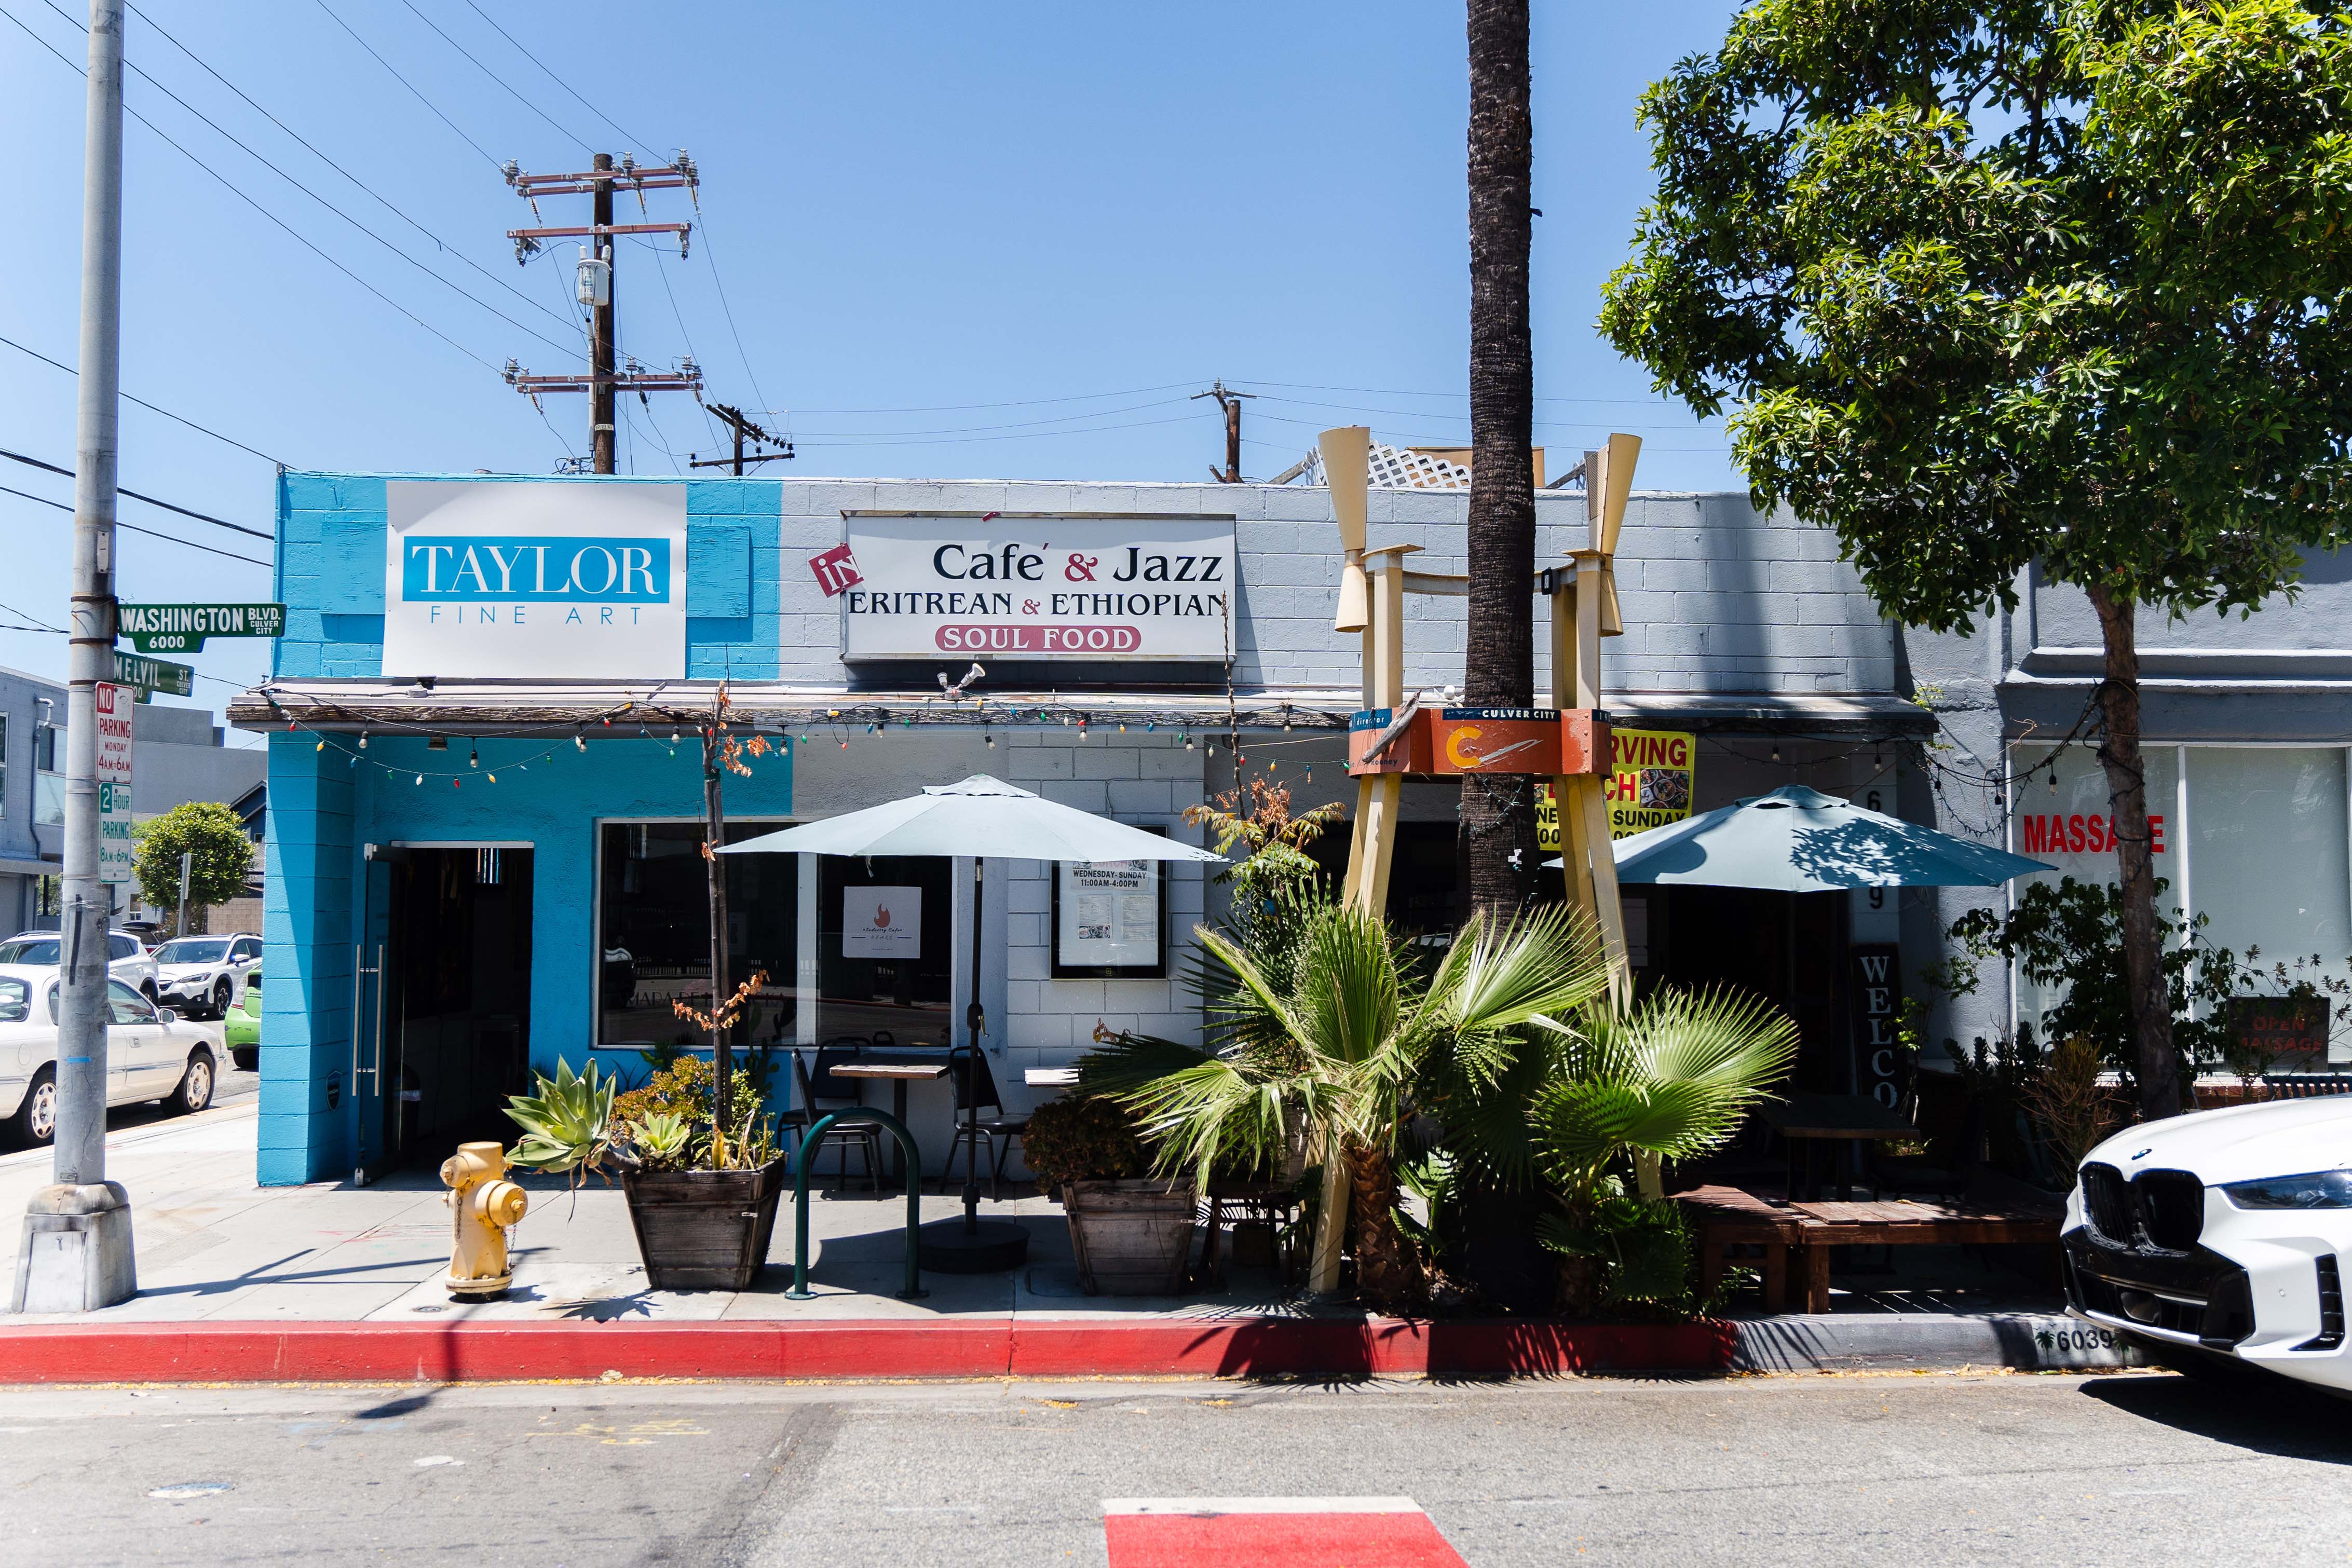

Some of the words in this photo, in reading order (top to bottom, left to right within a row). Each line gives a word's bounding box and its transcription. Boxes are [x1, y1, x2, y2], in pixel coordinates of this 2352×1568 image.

[412, 544, 661, 594] TAYLOR
[933, 542, 1049, 582] Café
[1065, 553, 1098, 582] &
[1113, 547, 1223, 582] Jazz
[849, 592, 1012, 615] ERITREAN
[1022, 599, 1041, 615] &
[1050, 593, 1226, 617] ETHIOPIAN
[120, 608, 244, 632] WASHINGTON
[248, 608, 281, 620] BLVD.
[431, 606, 525, 624] FINE
[566, 607, 641, 625] ART
[149, 636, 185, 649] 6000
[943, 628, 1029, 650] SOUL
[1043, 629, 1134, 650] FOOD
[114, 656, 160, 687] MELVIL
[176, 680, 191, 689] CULVER
[179, 688, 188, 696] CITY
[99, 687, 112, 710] NO
[1356, 715, 1385, 726] direor
[1482, 710, 1529, 718] CULVER
[1533, 711, 1555, 719] CITY
[100, 717, 130, 739] PARKING
[105, 741, 127, 753] MONDAY
[1611, 735, 1687, 767] RVING
[103, 787, 110, 809] 2
[114, 794, 129, 810] HOUR
[1613, 810, 1685, 827] SUNDAY
[103, 821, 129, 839] PARKING
[2023, 814, 2165, 853] MASSAE
[1081, 879, 1138, 888] 11:00AM-4:00PM
[2253, 1016, 2305, 1030] OPEN
[2234, 1037, 2322, 1053] ASAGE
[2057, 1329, 2113, 1352] 6039
